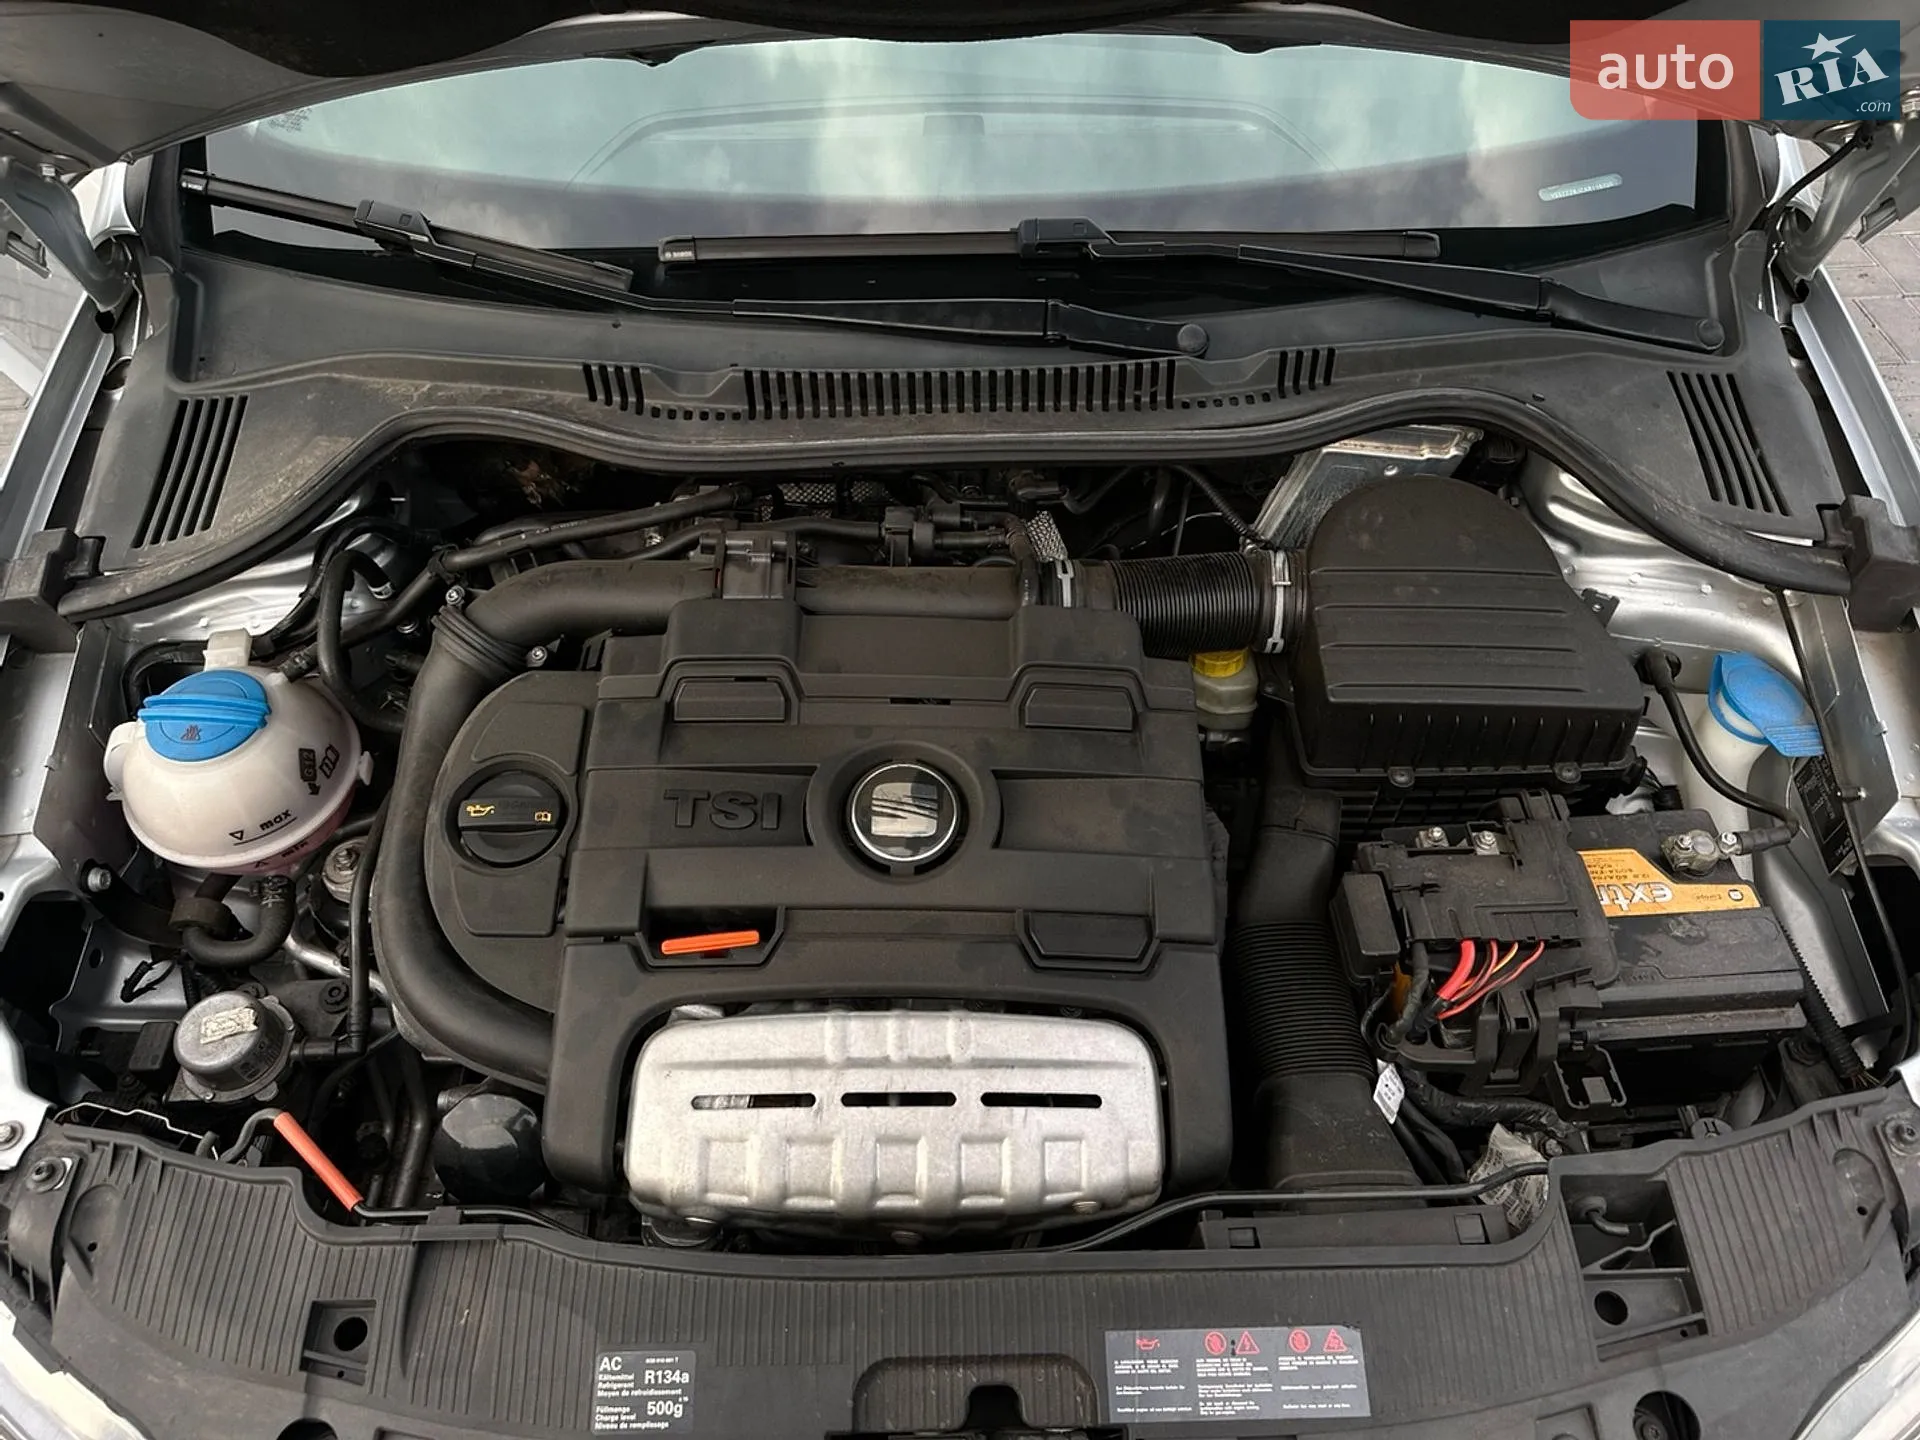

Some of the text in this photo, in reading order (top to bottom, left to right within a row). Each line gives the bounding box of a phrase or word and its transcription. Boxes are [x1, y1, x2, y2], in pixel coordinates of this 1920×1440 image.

[663, 788, 781, 830] TSI
[260, 809, 292, 831] max
[600, 1356, 622, 1371] AC
[644, 1369, 690, 1384] R134a
[647, 1400, 683, 1418] 500g
